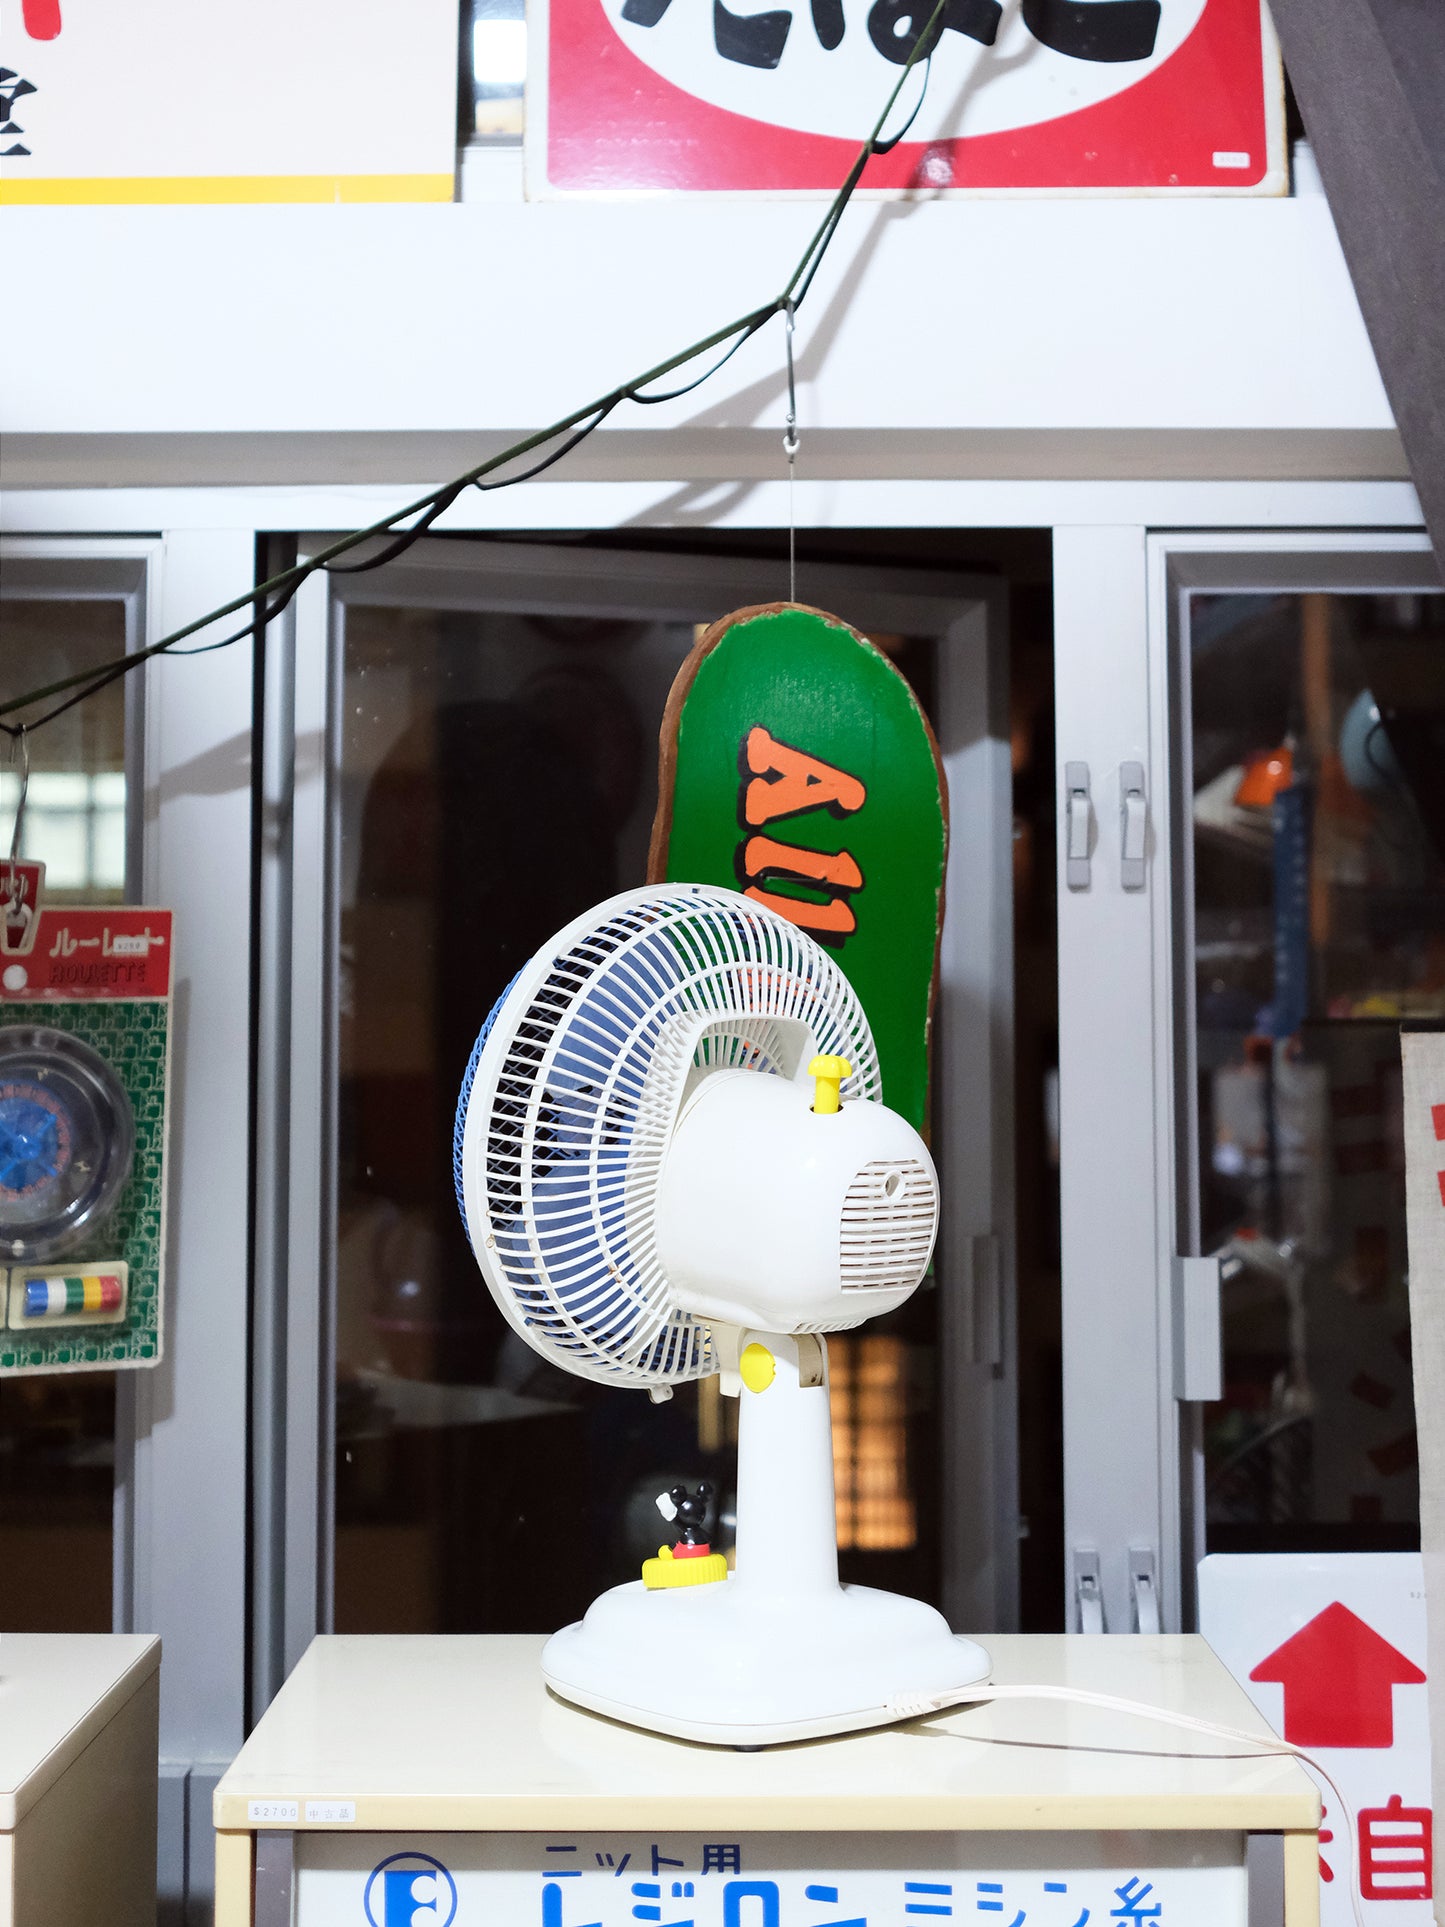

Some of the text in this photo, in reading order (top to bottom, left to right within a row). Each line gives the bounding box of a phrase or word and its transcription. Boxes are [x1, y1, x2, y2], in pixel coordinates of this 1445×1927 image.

[309, 1808, 350, 1819] 中古品
[542, 1844, 740, 1877] ニット用
